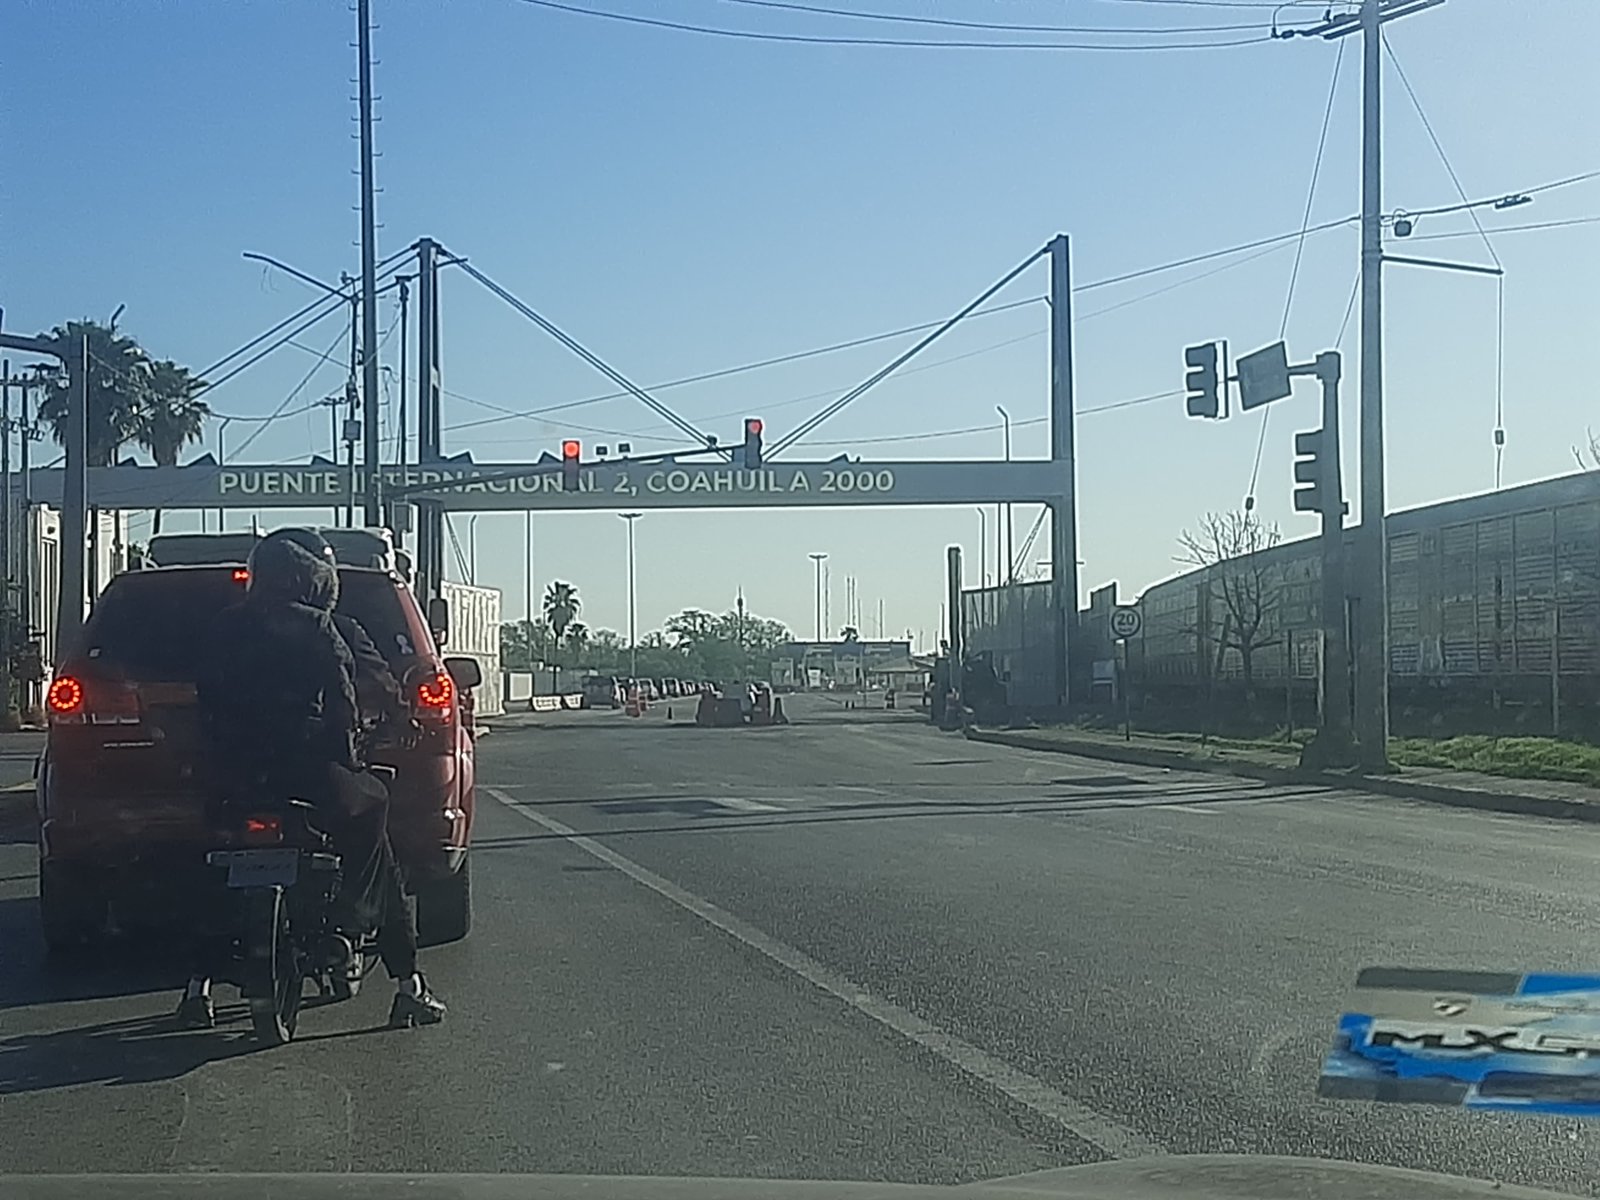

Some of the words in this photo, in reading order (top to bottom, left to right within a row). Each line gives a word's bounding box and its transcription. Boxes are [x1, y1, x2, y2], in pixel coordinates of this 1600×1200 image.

[219, 471, 342, 494] PUENTE
[613, 471, 638, 497] 2,
[819, 469, 894, 492] 2000
[1117, 613, 1135, 626] 20
